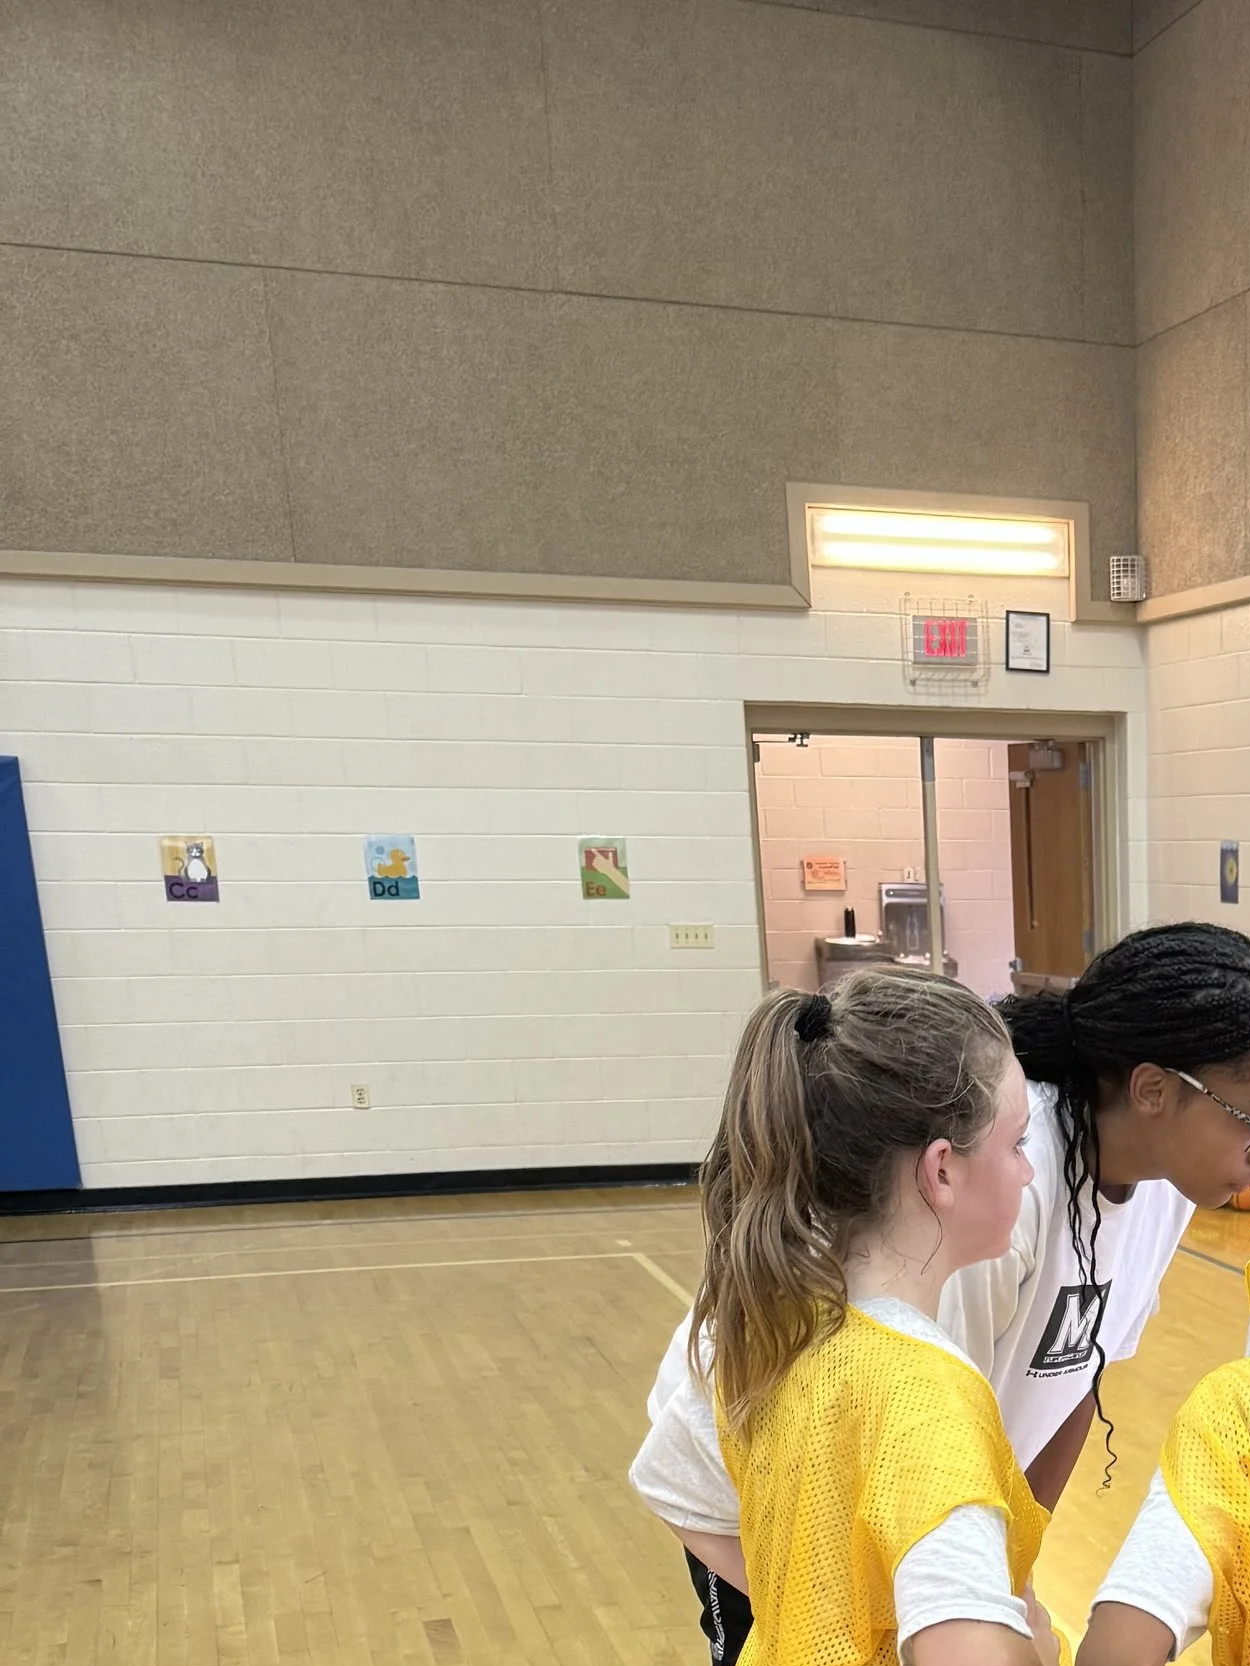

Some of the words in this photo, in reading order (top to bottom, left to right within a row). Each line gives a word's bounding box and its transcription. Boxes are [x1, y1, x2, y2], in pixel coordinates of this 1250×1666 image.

[924, 618, 967, 657] EXIT
[170, 882, 198, 899] Cc
[373, 880, 399, 897] Dd
[586, 881, 606, 897] Ee
[1046, 1289, 1106, 1354] M
[1038, 1370, 1062, 1378] UNDER
[1063, 1363, 1089, 1375] ARMOUR
